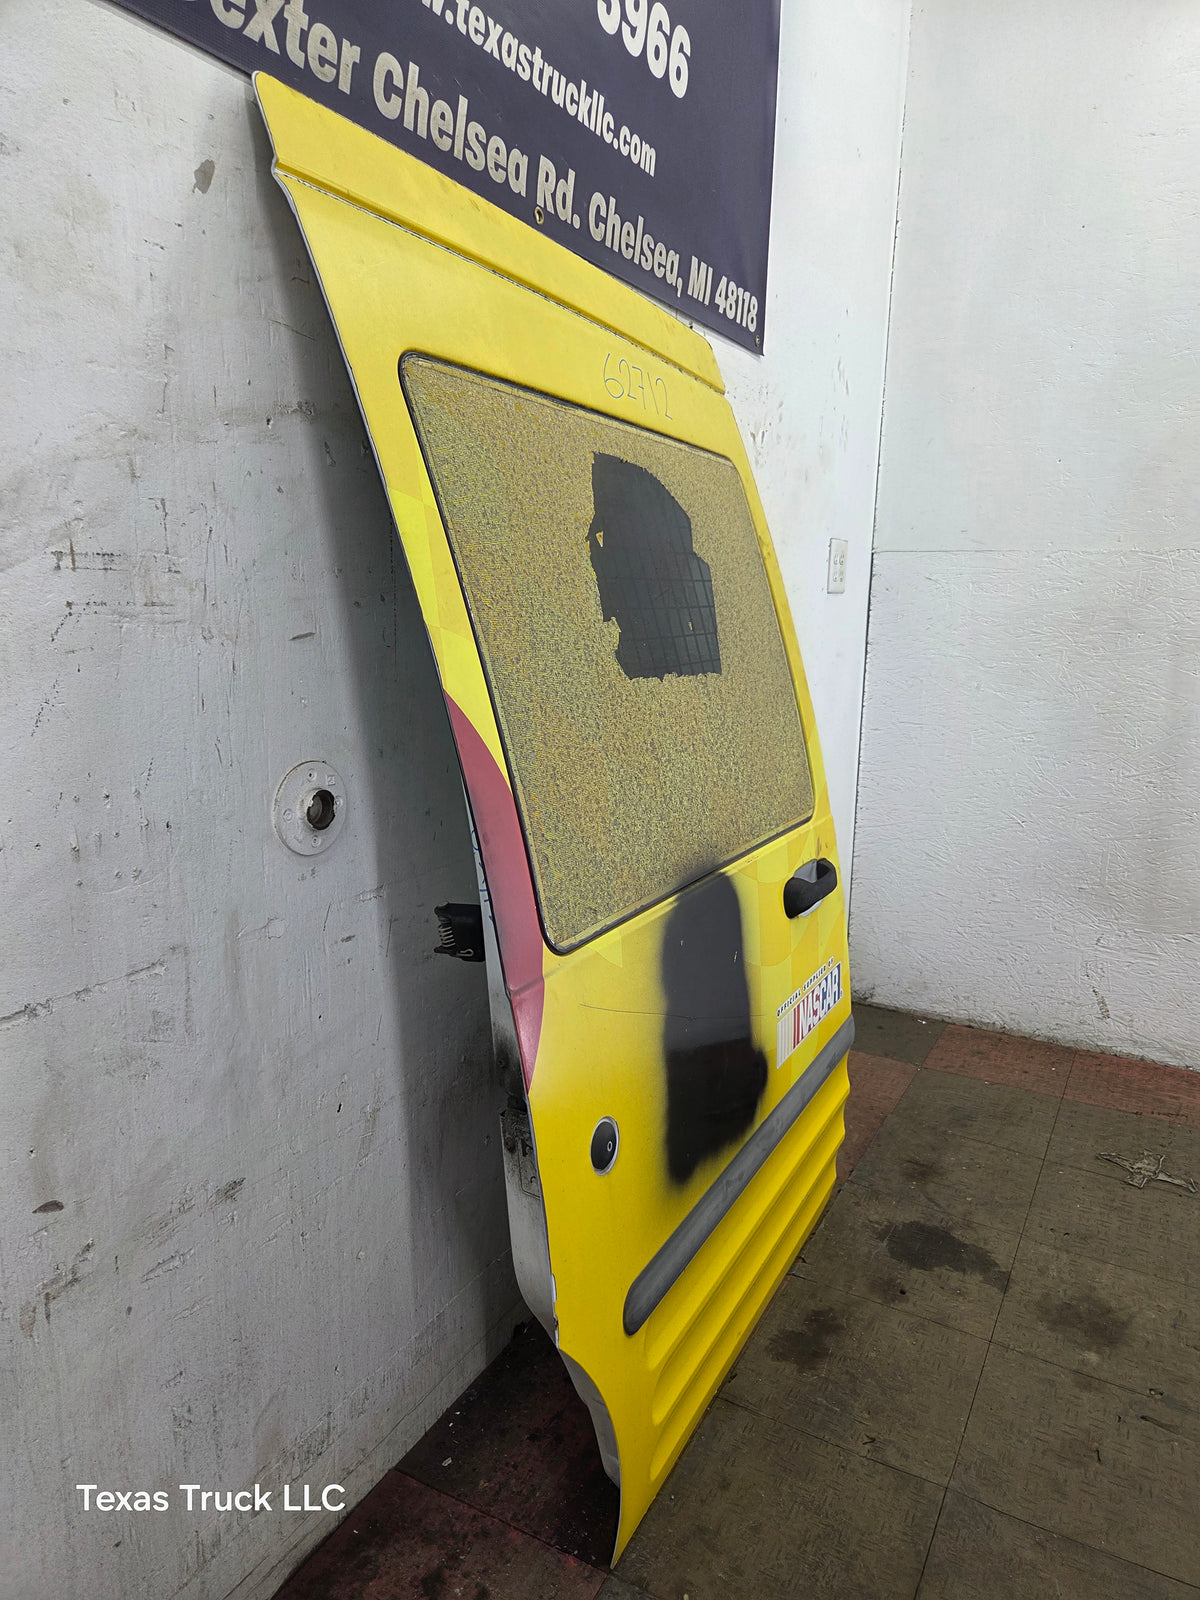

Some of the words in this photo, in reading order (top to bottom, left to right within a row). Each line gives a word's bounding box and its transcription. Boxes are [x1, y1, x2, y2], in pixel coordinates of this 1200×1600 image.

[373, 52, 529, 198] Chelsea
[536, 154, 581, 229] Rd.
[588, 191, 684, 298] Chelsea,
[687, 255, 713, 306] MI
[714, 275, 759, 333] 48118
[603, 353, 673, 420] 62712
[798, 964, 841, 1042] NASCAR
